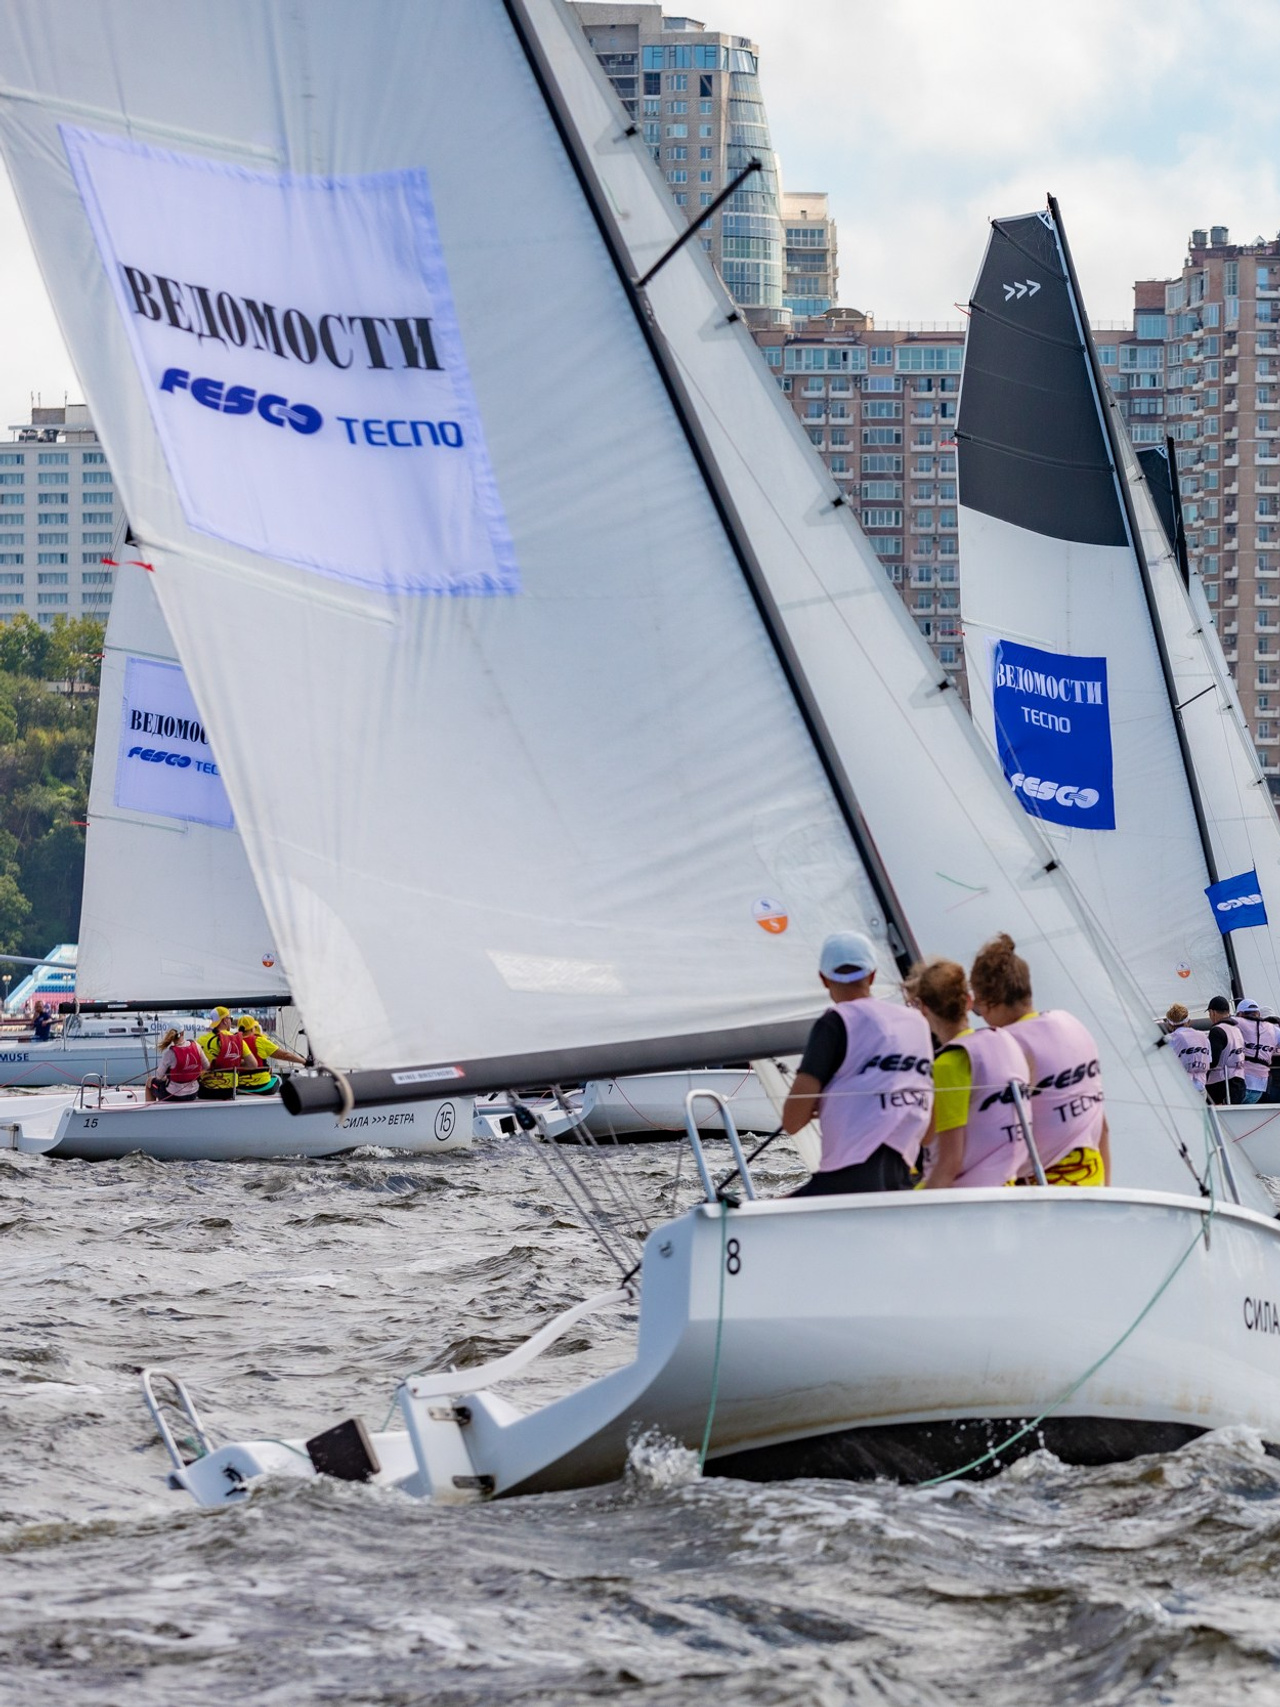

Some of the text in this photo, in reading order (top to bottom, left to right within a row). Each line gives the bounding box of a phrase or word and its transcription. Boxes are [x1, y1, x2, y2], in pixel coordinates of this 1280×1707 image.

[123, 265, 446, 371] ВЕДОМОСТИ
[159, 367, 465, 448] FESCO TECNO
[1021, 706, 1072, 734] TECNO
[127, 746, 221, 776] FESCO TEC
[1010, 772, 1100, 809] FESCO
[607, 1083, 614, 1095] 7
[83, 1118, 99, 1128] 15
[387, 1112, 415, 1126] ВЕТРА
[439, 1110, 453, 1133] 15
[726, 1237, 742, 1276] 8
[1243, 1296, 1280, 1336] СИЛА
